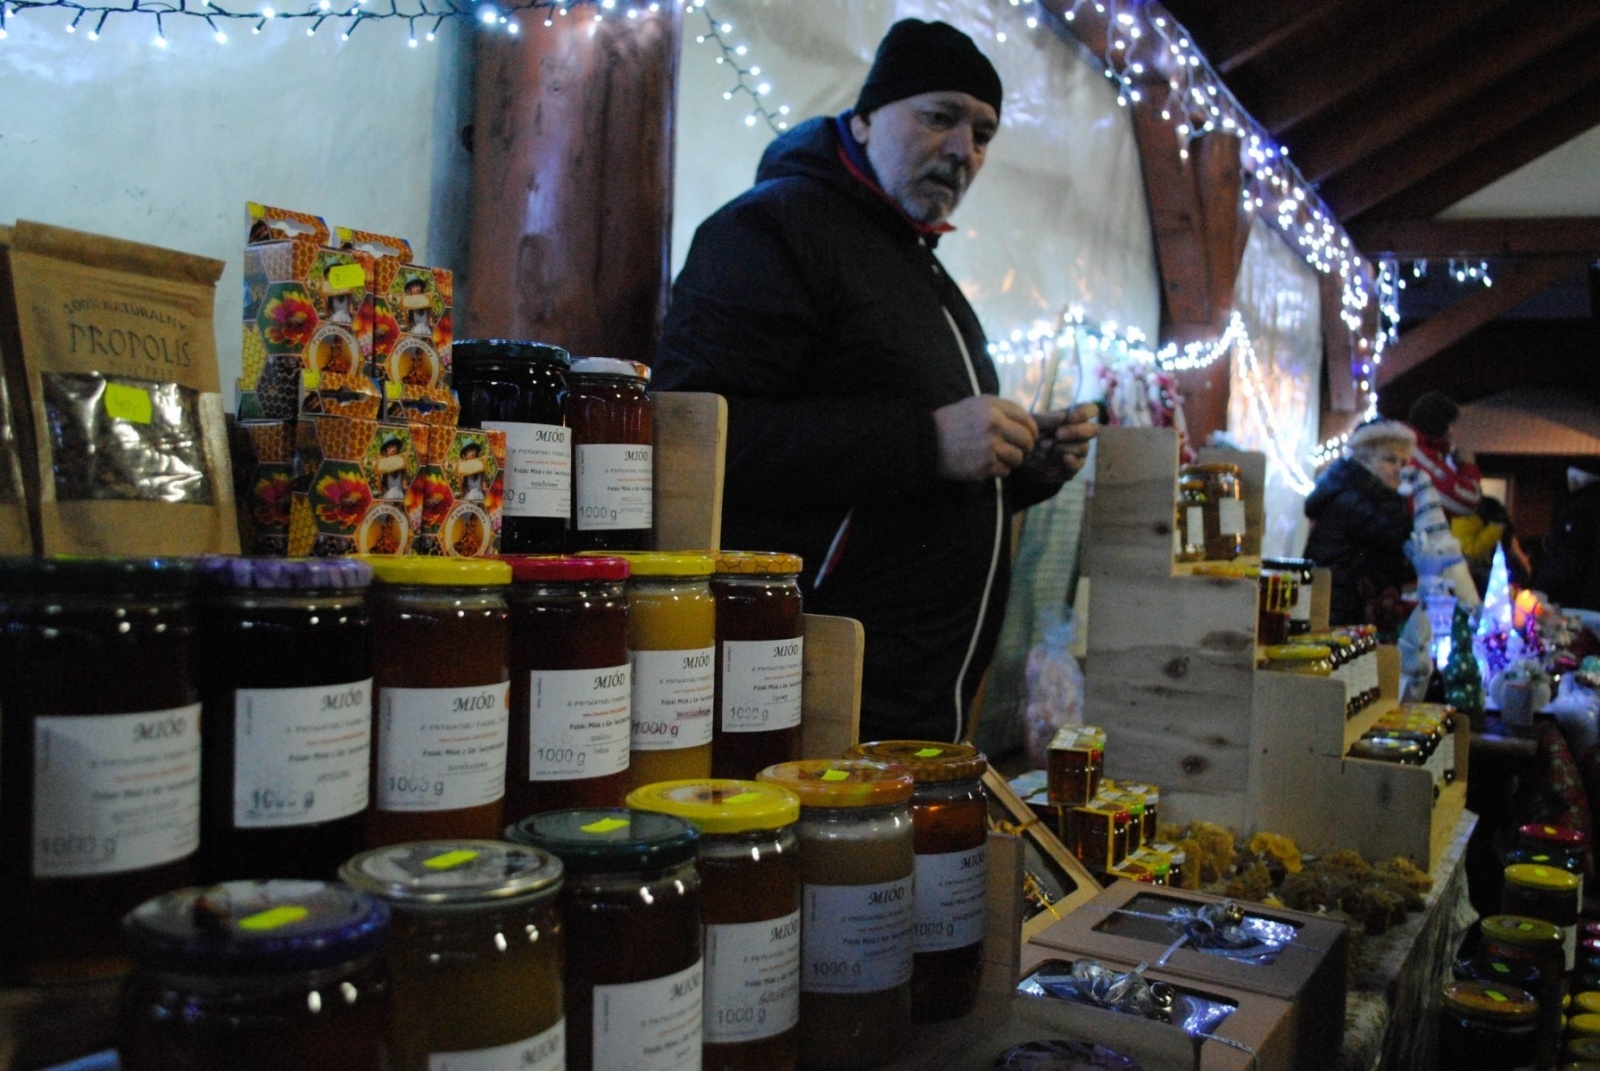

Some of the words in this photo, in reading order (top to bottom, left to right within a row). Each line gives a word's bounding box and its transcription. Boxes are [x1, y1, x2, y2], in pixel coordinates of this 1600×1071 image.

[68, 322, 192, 368] PROPOLIS
[535, 428, 565, 443] MIÓD
[624, 447, 649, 462] MIÓD
[518, 492, 526, 505] g
[580, 505, 607, 519] 1000
[610, 508, 617, 522] g
[772, 641, 799, 658] MIÓD
[682, 651, 710, 670] MIÓD
[593, 669, 626, 690] MIÓD
[452, 690, 496, 713] MIÓD
[762, 709, 769, 722] g
[633, 720, 668, 735] 1000
[670, 724, 679, 738] g
[537, 747, 573, 763] 1000
[576, 751, 586, 766] g
[388, 775, 429, 793] 1000
[434, 780, 444, 796] g
[868, 883, 905, 905] MIÓD
[914, 922, 943, 936] 1000
[946, 923, 954, 937] g
[813, 961, 848, 976] 1000
[717, 1006, 754, 1024] 1000
[757, 1007, 767, 1025] g
